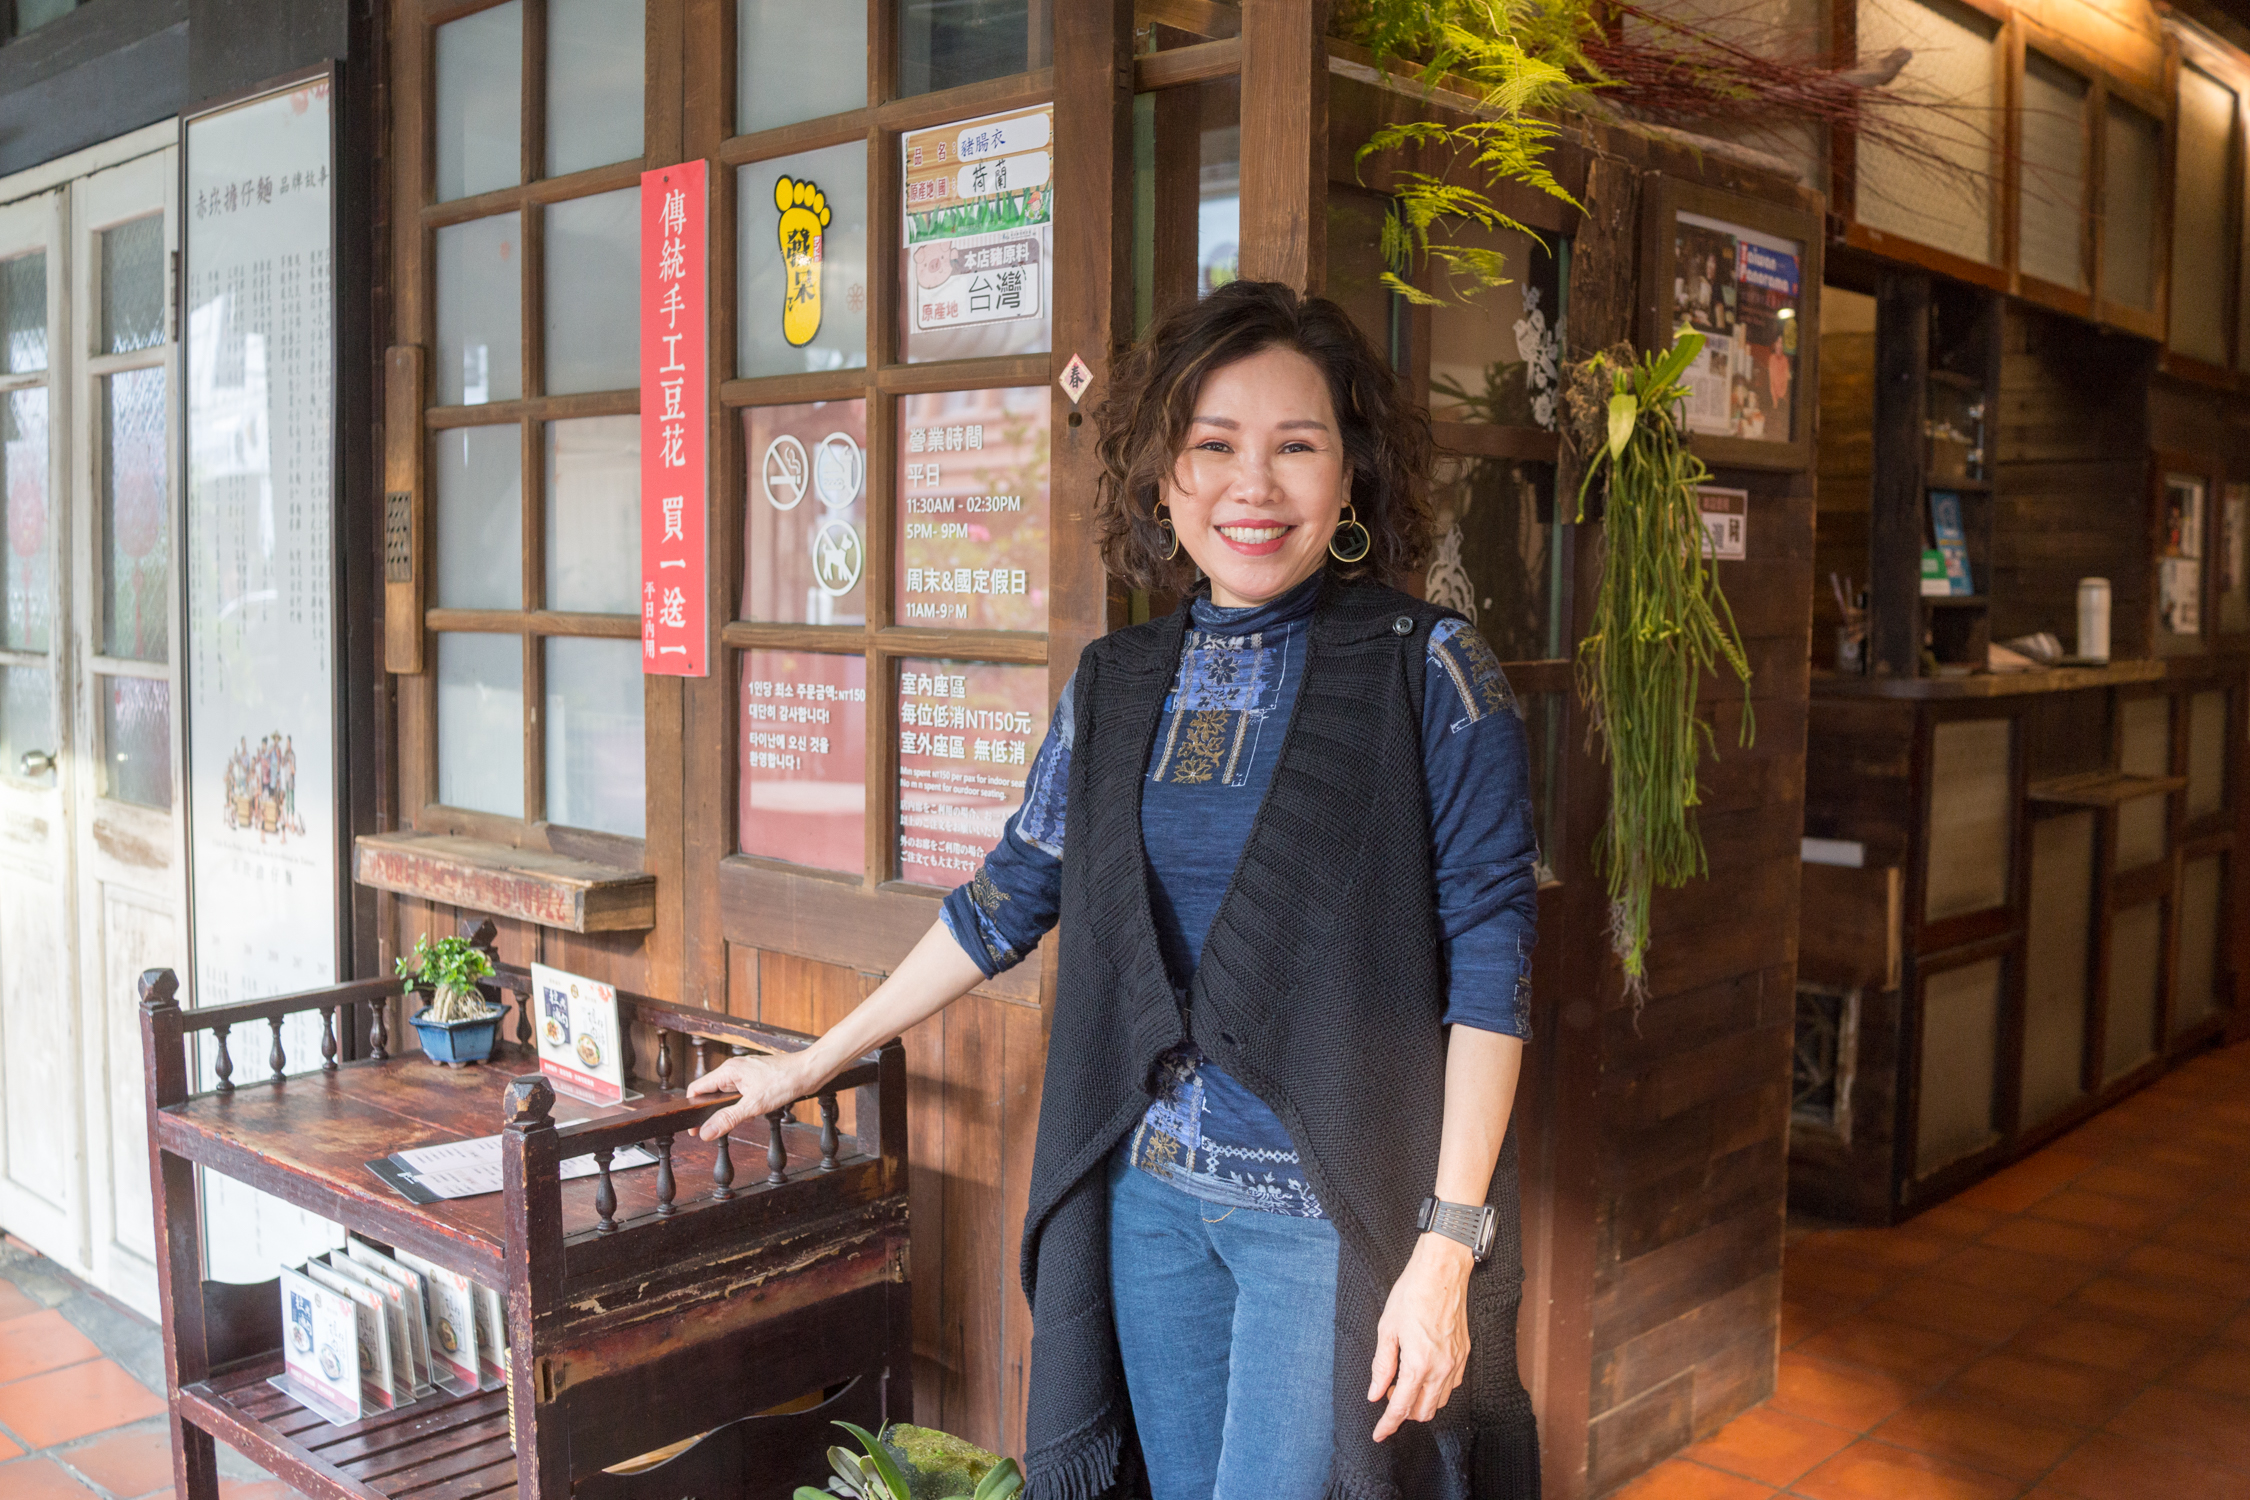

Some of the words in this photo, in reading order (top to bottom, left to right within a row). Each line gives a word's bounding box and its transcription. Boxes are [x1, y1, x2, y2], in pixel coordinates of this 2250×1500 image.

[960, 128, 1006, 157] 豬腸衣
[972, 158, 1007, 193] 荷蘭
[964, 242, 1030, 269] 本店豬原料
[968, 270, 1022, 314] 台灣
[921, 301, 959, 323] 原產地
[658, 191, 687, 469] 傳統手工豆花
[1069, 365, 1085, 389] 春
[909, 425, 983, 452] 營業時間
[907, 463, 940, 488] 平日
[906, 497, 955, 513] 11:30AM
[966, 496, 1021, 512] 02:30PM
[658, 494, 687, 656] 買一送一
[906, 567, 1026, 595] 周末&國定假日
[644, 581, 656, 659] 平日內用
[748, 681, 773, 697] 1인당
[774, 682, 794, 698] 최소
[901, 672, 966, 699] 室內座區
[748, 703, 777, 720] 대단히
[779, 705, 830, 724] 감사합니다!
[749, 732, 786, 750] 타이난에
[788, 735, 807, 752] 오신
[810, 737, 830, 754] 것을
[901, 731, 966, 760] 室外座區
[973, 737, 1025, 765] 無低消
[900, 778, 910, 788] No
[924, 782, 942, 793] spent
[943, 783, 952, 793] for
[914, 768, 931, 779] spent
[932, 770, 951, 780] NT150
[951, 772, 962, 782] per
[963, 774, 976, 784] pax
[977, 773, 987, 784] for
[988, 775, 1010, 787] indoor
